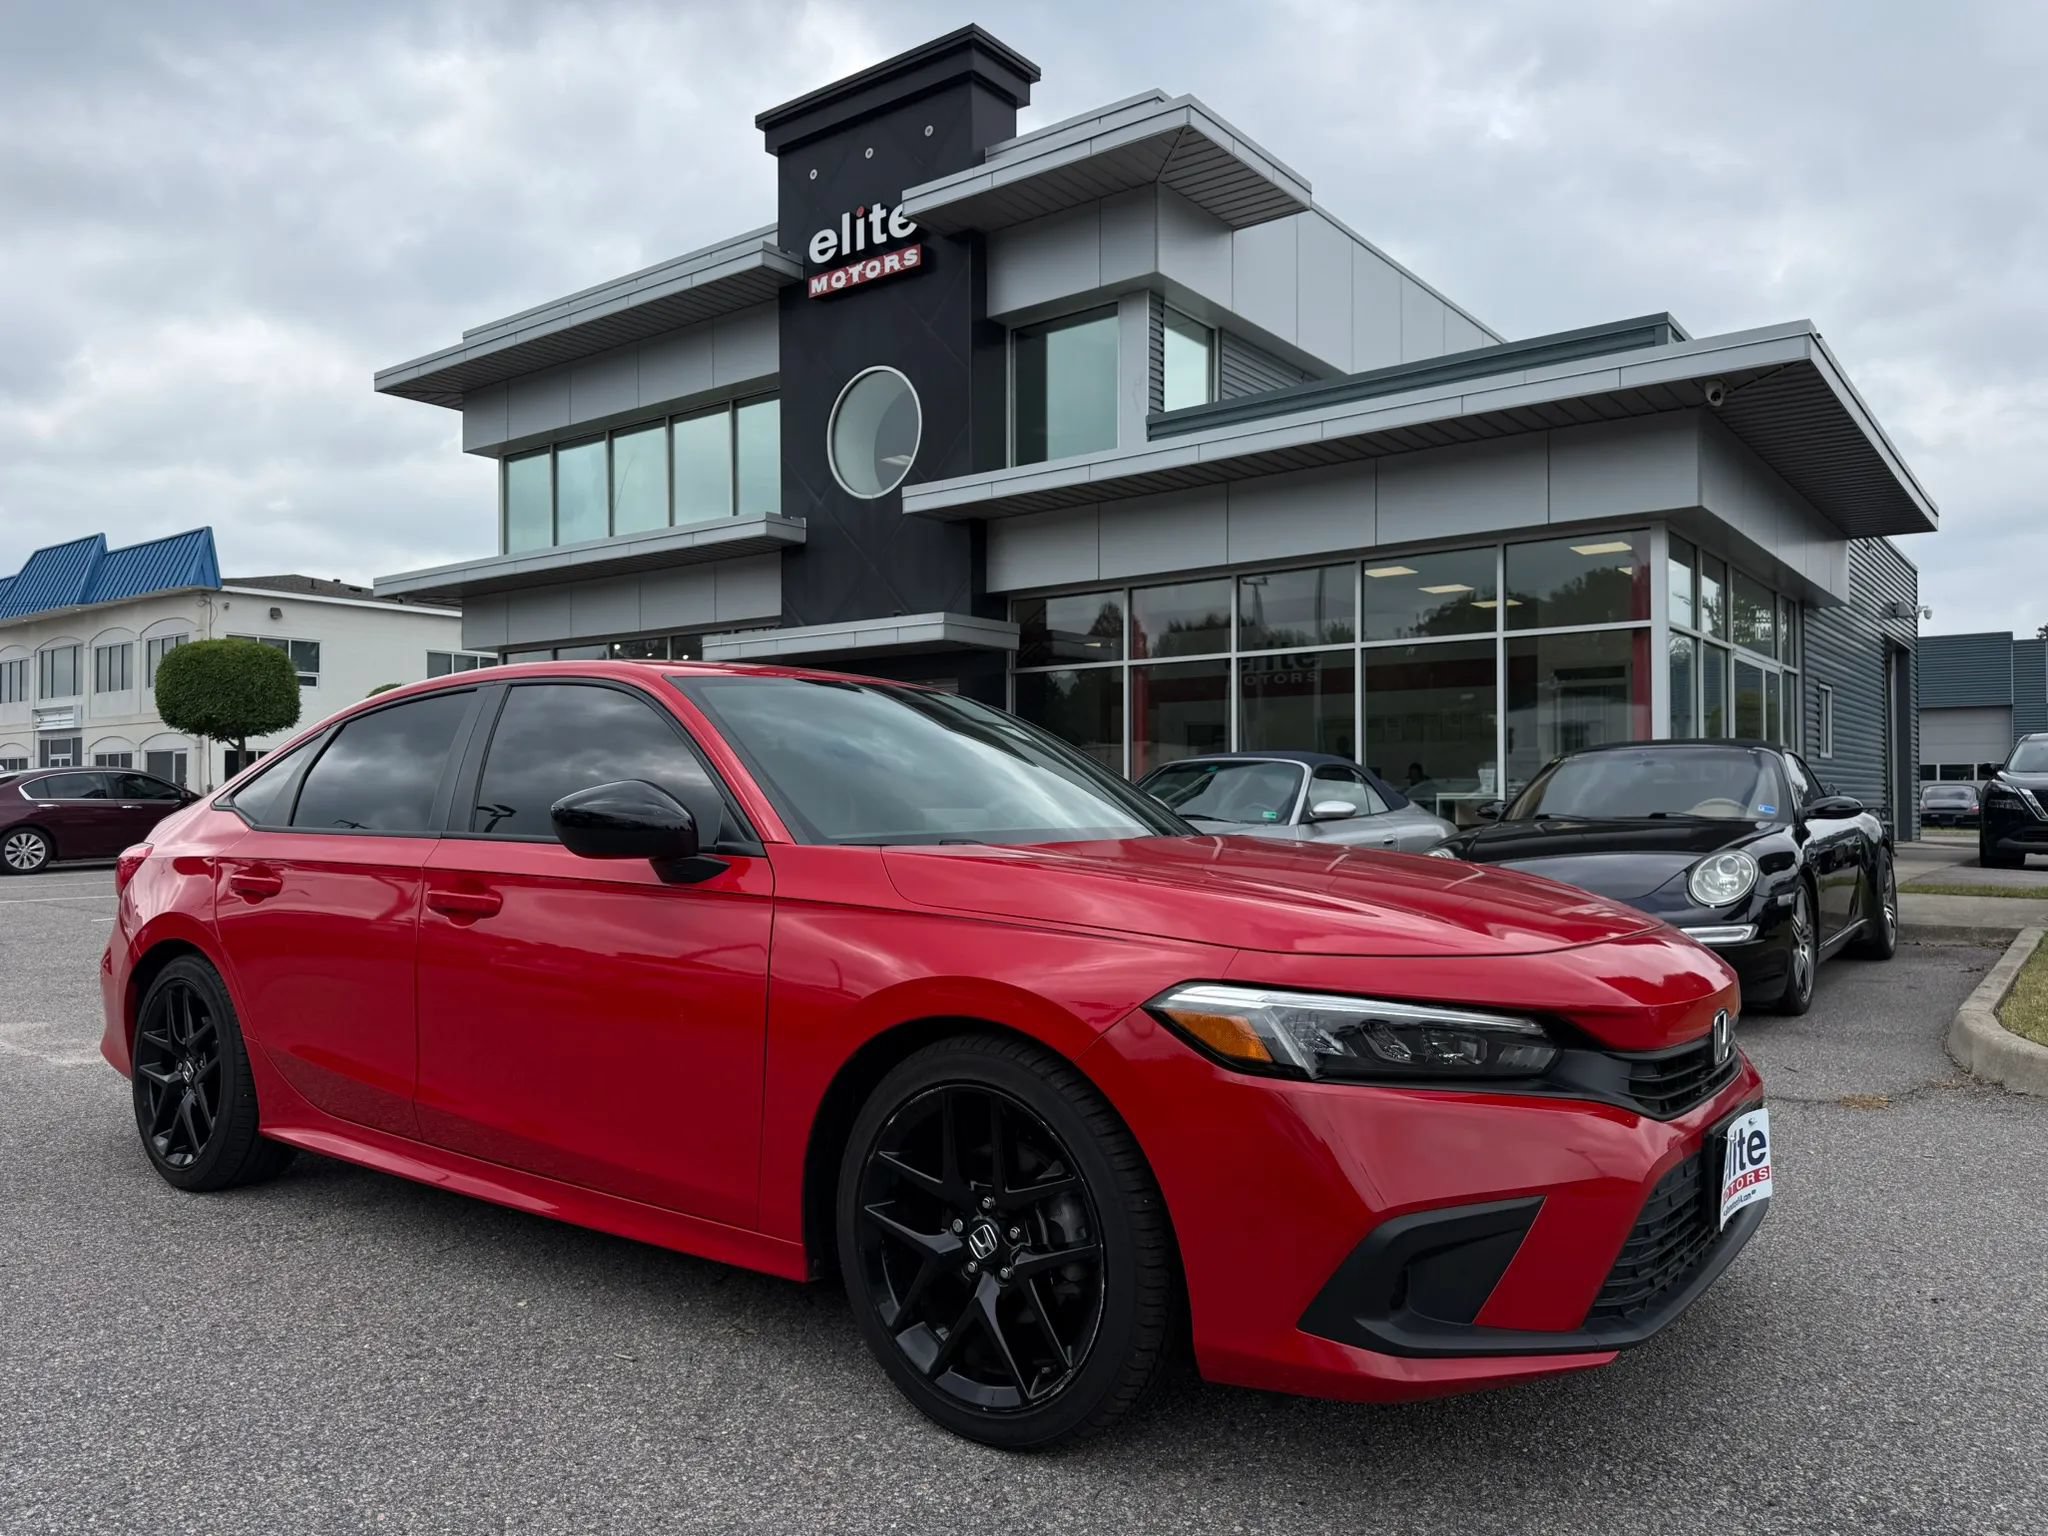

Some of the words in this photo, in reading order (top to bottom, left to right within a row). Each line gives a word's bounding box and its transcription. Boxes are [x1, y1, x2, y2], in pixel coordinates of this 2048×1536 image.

[808, 202, 918, 264] elite
[810, 248, 919, 294] MOTORS
[1243, 672, 1318, 687] OTORS
[1722, 1168, 1769, 1202] OTORS
